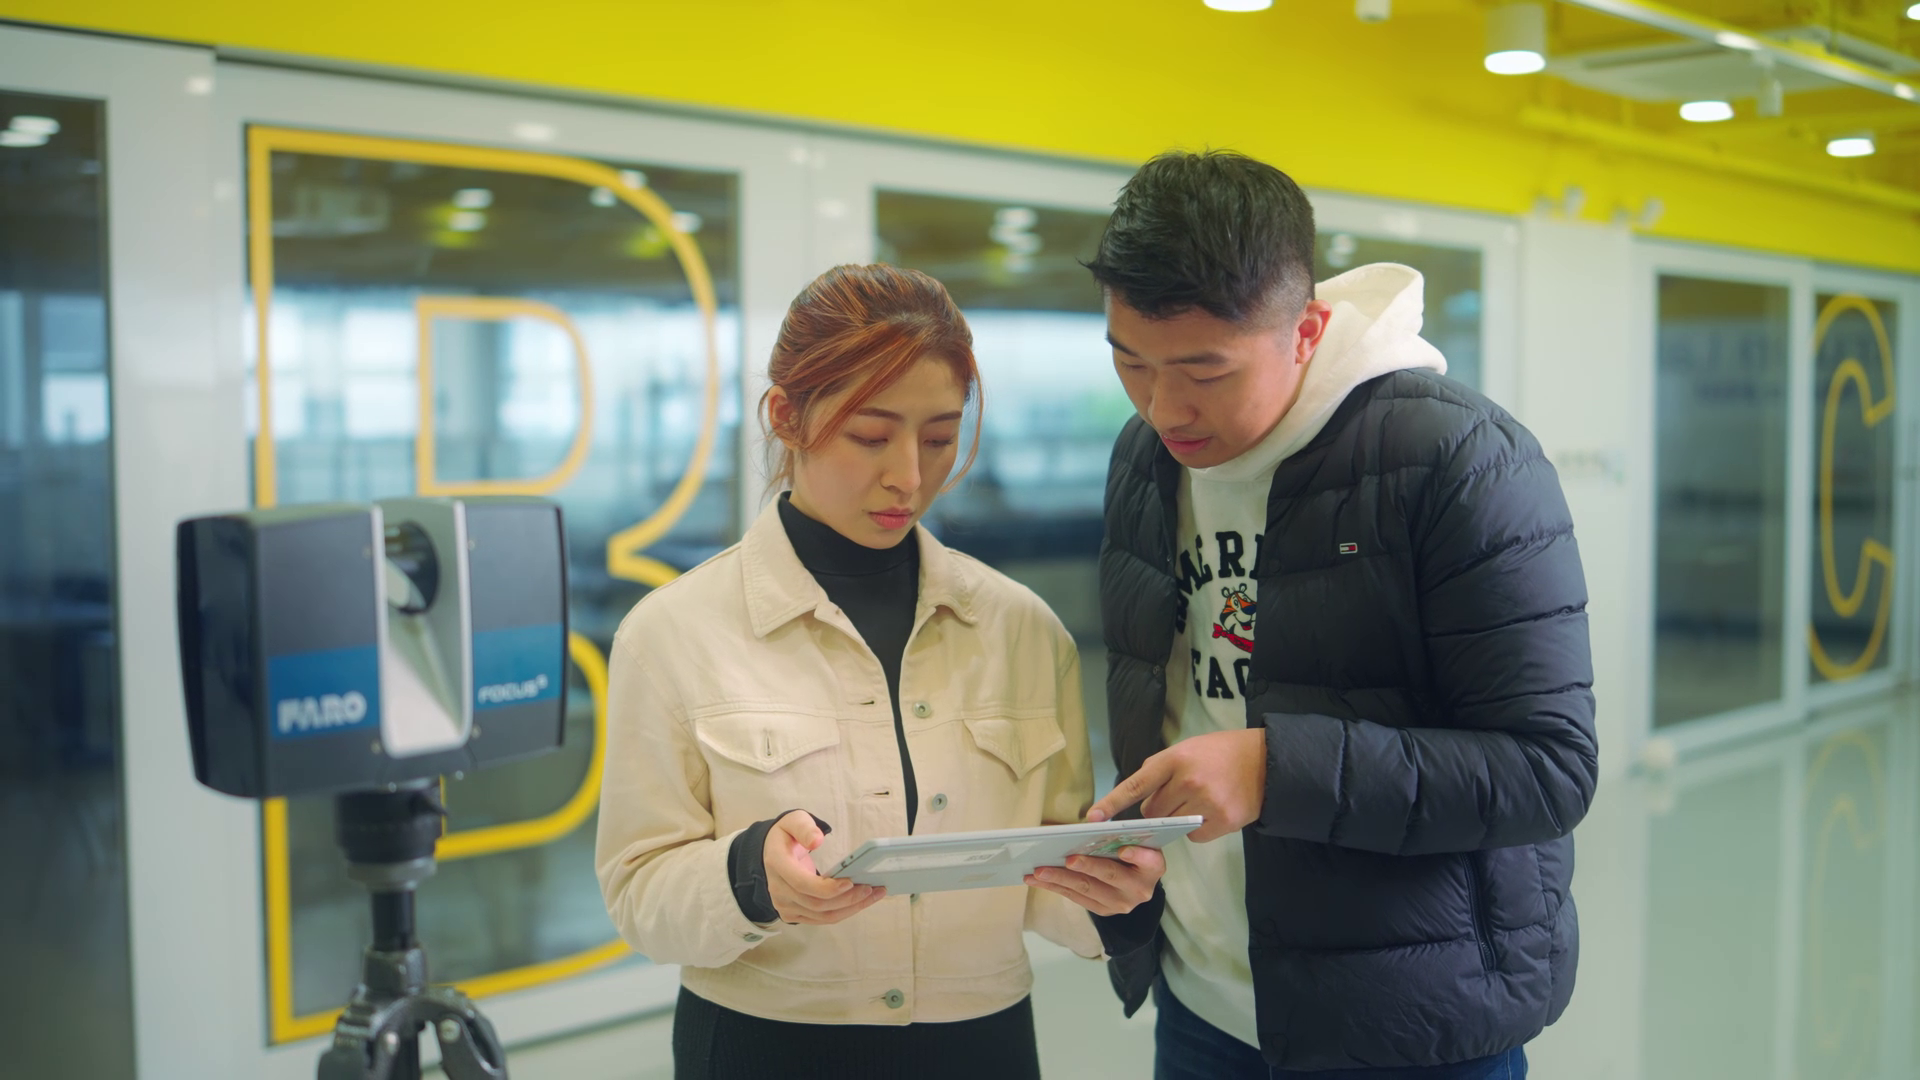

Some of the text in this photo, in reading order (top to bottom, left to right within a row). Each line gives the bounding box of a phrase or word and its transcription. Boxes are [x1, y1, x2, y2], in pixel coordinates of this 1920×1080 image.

[248, 126, 717, 1044] B
[1809, 294, 1895, 681] C
[278, 690, 367, 734] FARO
